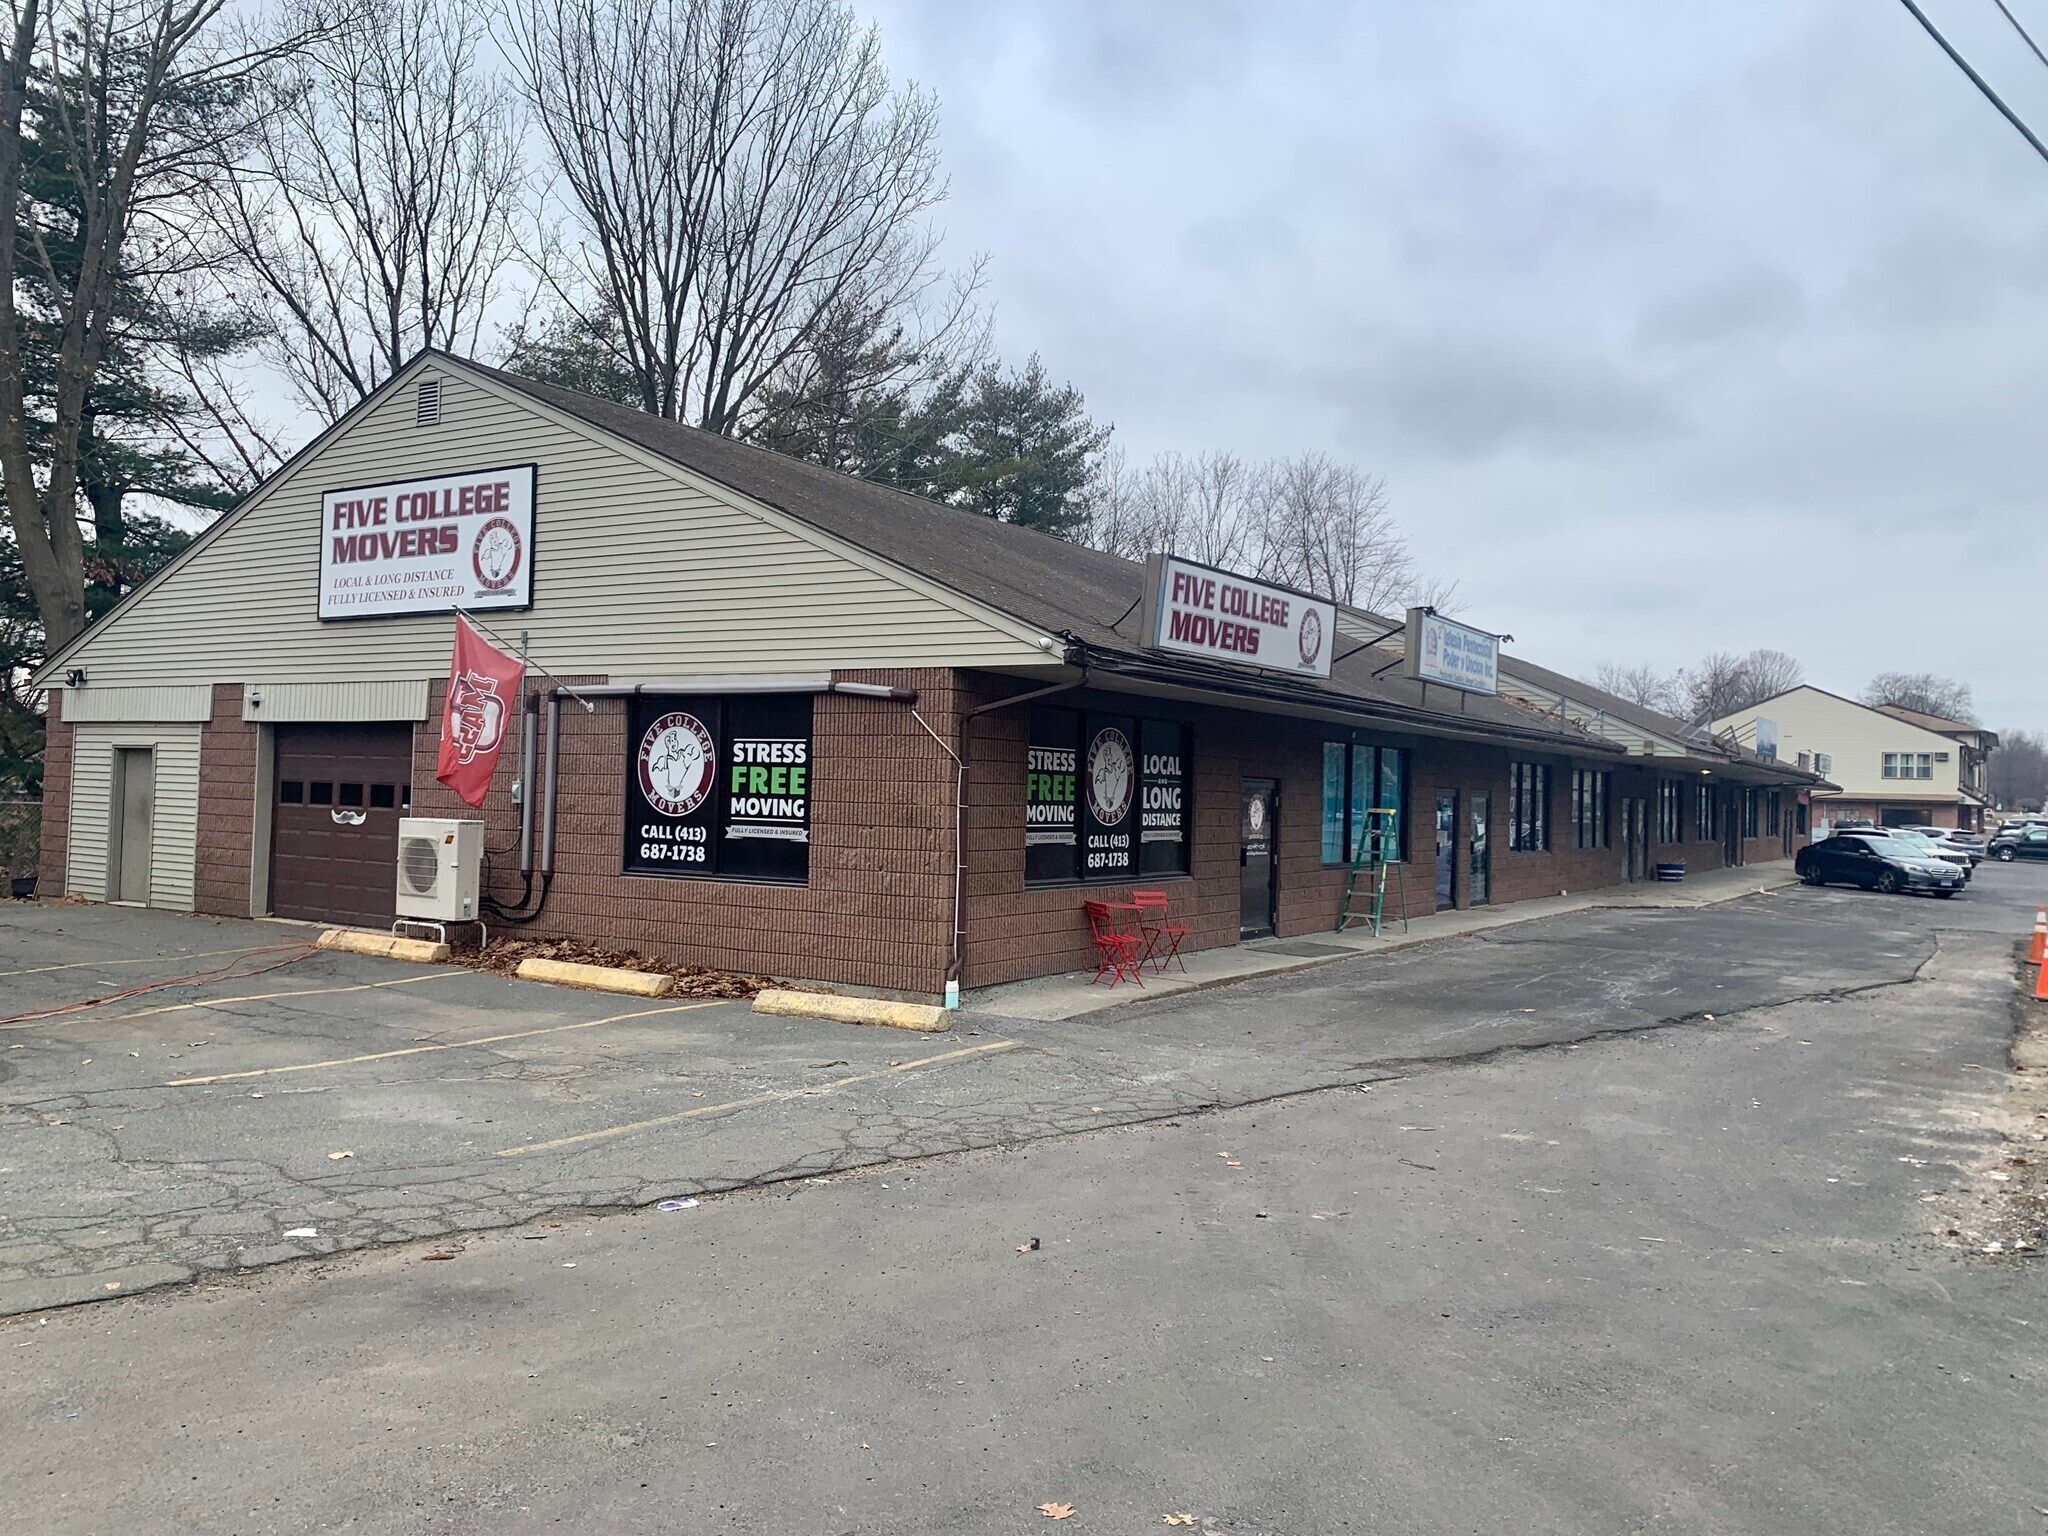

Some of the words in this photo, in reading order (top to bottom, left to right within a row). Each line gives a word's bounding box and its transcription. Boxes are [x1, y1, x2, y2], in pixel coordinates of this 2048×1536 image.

[332, 496, 388, 531] FIVE
[395, 481, 510, 523] COLLEGE
[331, 523, 459, 565] MOVERS
[334, 574, 364, 589] LOCAL
[365, 575, 373, 586] &
[374, 572, 401, 586] LONG
[403, 569, 455, 583] DISTANCE
[327, 592, 357, 606] FULLY
[358, 589, 407, 603] LICENSED
[408, 590, 416, 600] &
[418, 585, 465, 599] INSURED
[1172, 571, 1216, 610] FIVE
[1220, 583, 1290, 629] COLLEGE
[1168, 610, 1261, 655] MOVERS
[640, 724, 664, 762] FIVE
[667, 715, 713, 763] COLLEGE
[733, 743, 807, 764] STRESS
[1028, 750, 1076, 772] STRESS
[1143, 754, 1182, 776] LOCAL
[731, 766, 806, 795] FREE
[1027, 774, 1076, 801] FREE
[648, 790, 703, 814] MOVERS
[730, 797, 805, 817] MOVING
[1142, 786, 1182, 810] LONG
[1026, 804, 1074, 822] MOVING
[1092, 800, 1127, 823] MOVERS
[1142, 813, 1181, 827] DISTANCE
[641, 824, 673, 839] CALL
[675, 825, 707, 843] (413)
[1088, 834, 1109, 848] CALL
[1110, 833, 1130, 849] (413)
[640, 843, 706, 862] 687-1738
[1087, 852, 1129, 869] 687-1738
